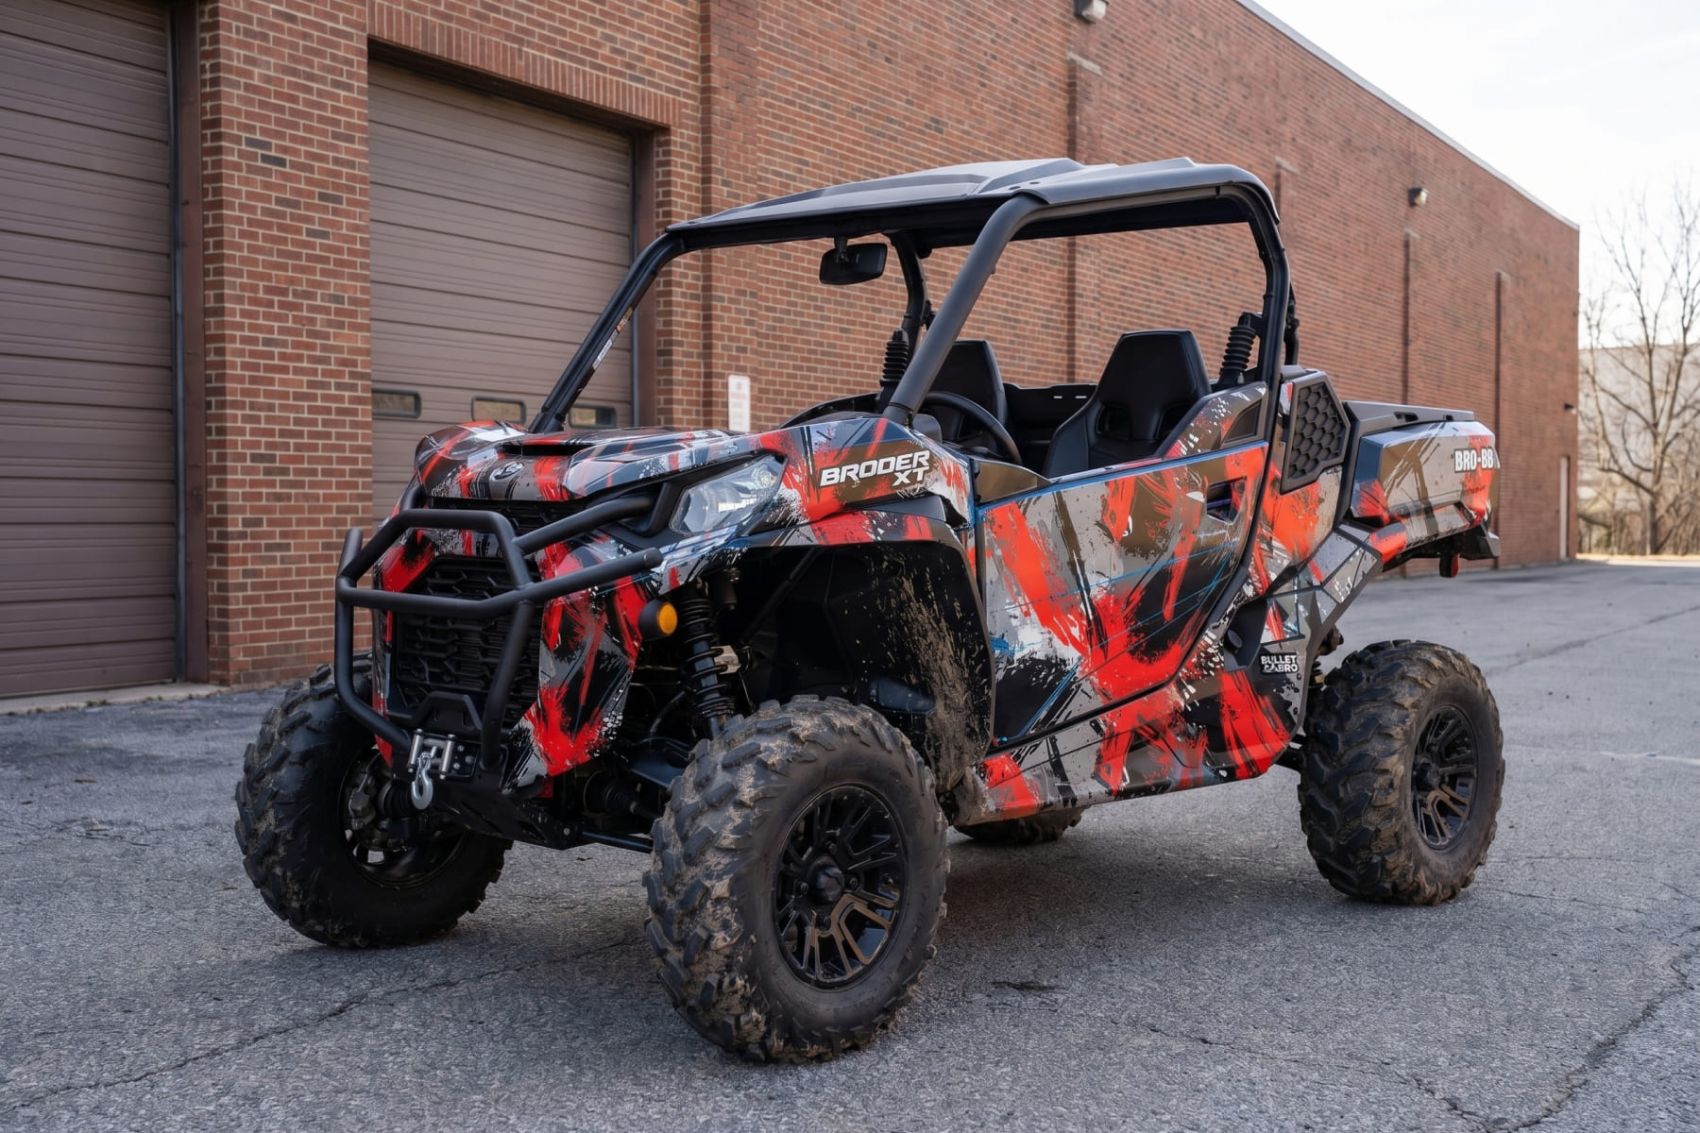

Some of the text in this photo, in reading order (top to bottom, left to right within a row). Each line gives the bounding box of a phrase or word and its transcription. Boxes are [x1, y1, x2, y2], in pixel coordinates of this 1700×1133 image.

[820, 450, 930, 487] BRODER
[892, 466, 929, 486] XT
[1261, 655, 1297, 664] BULLET
